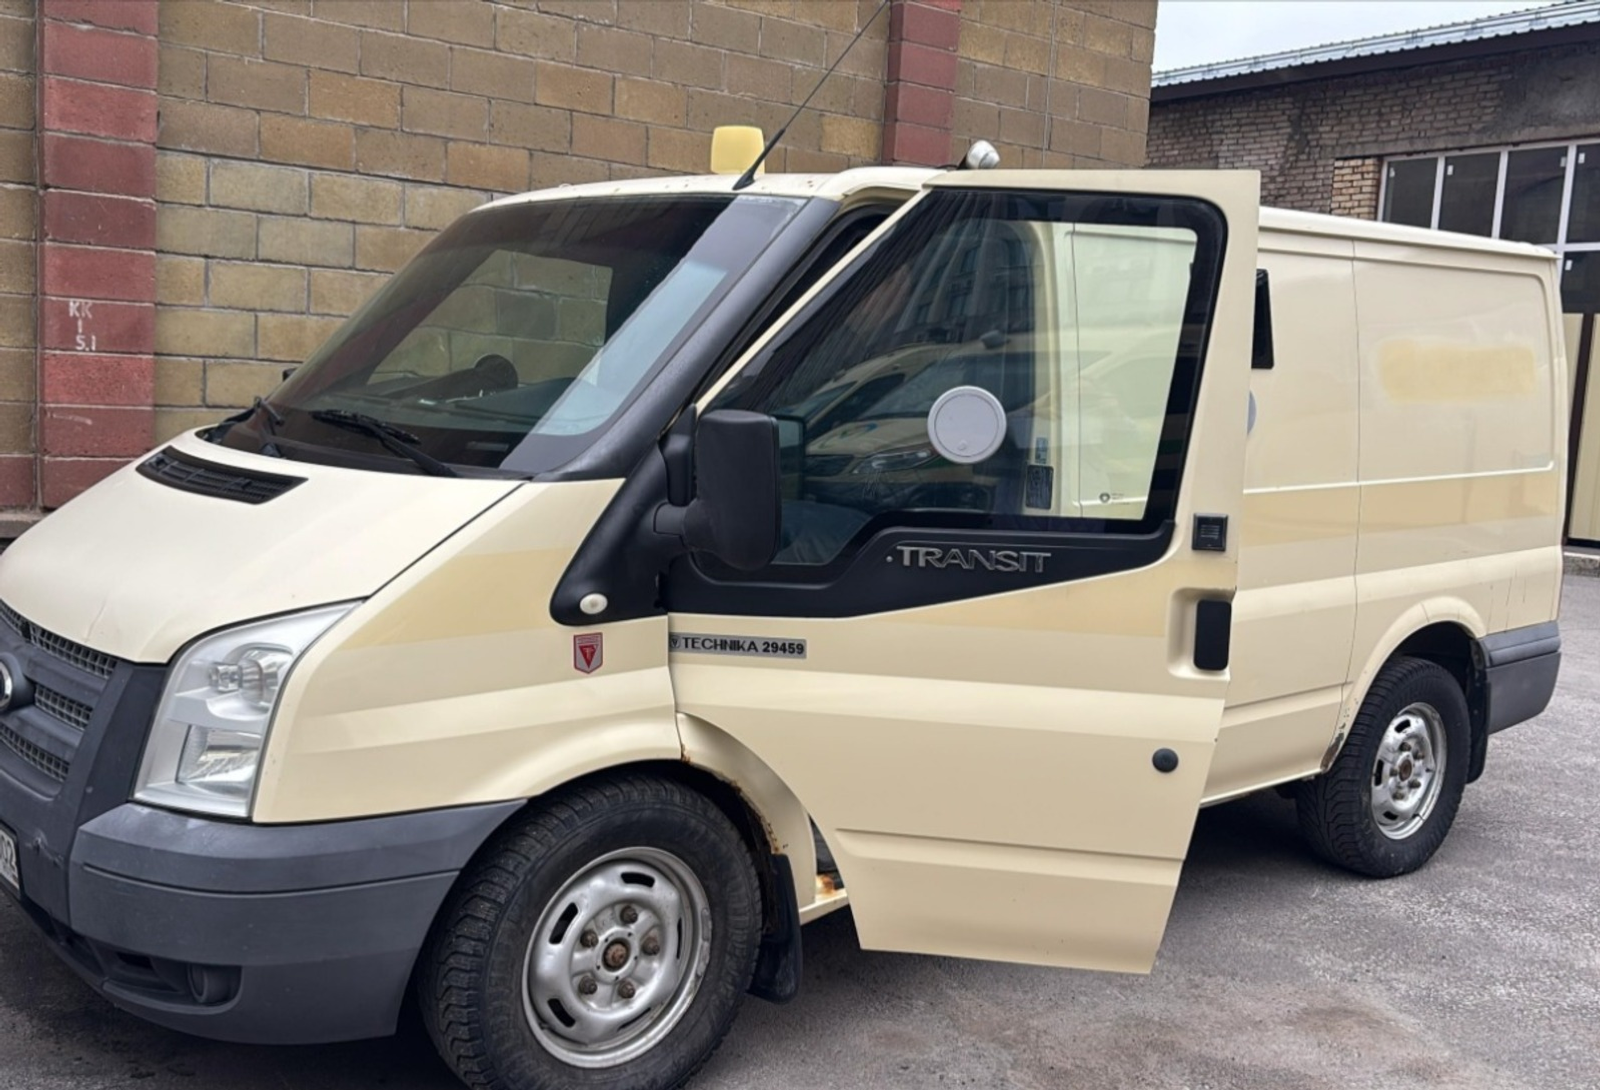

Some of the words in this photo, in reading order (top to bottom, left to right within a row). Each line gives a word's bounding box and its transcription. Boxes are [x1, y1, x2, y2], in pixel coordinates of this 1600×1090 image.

[69, 300, 92, 318] KK
[896, 545, 1051, 573] TRANSIT
[682, 636, 758, 653] TECHNIKA
[762, 641, 804, 655] 29459
